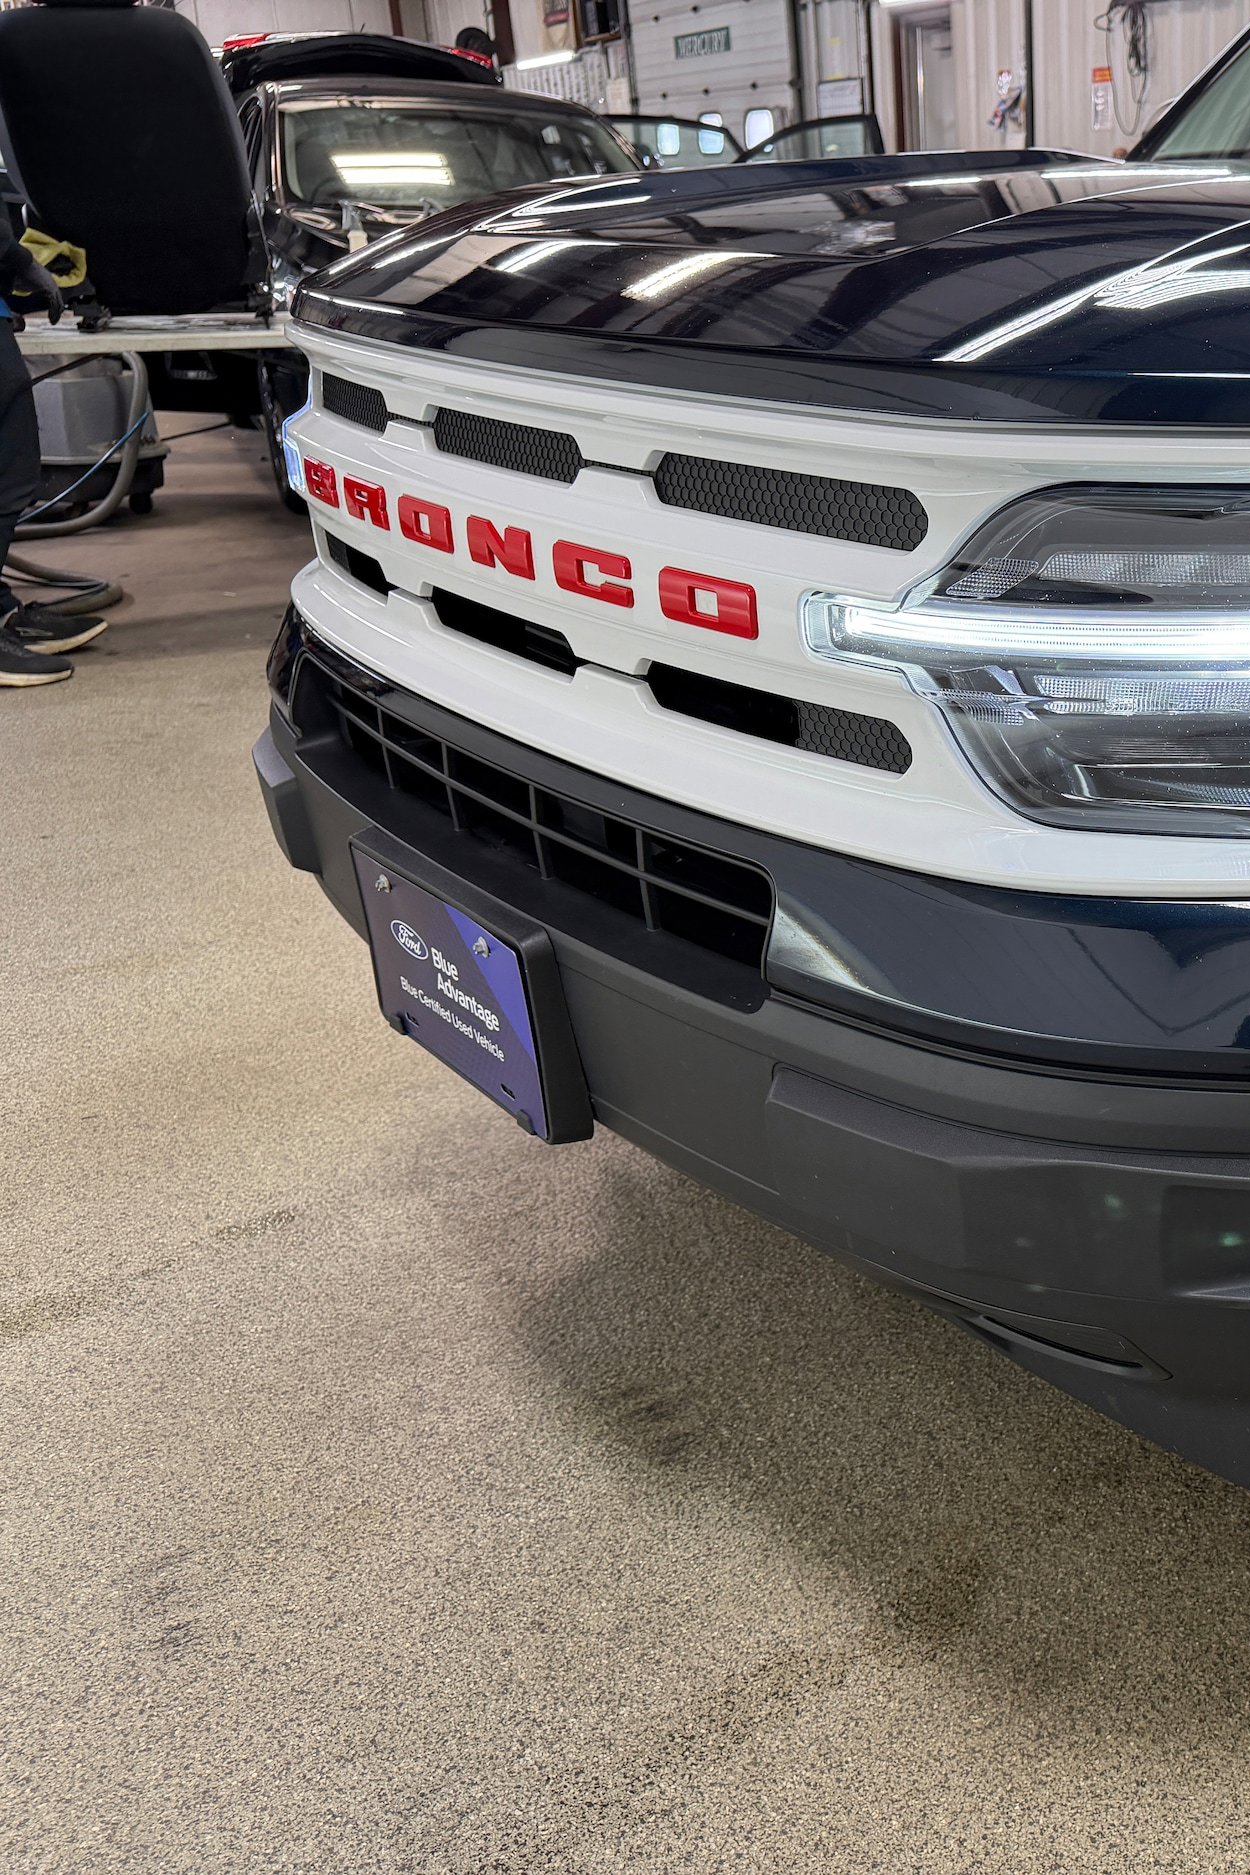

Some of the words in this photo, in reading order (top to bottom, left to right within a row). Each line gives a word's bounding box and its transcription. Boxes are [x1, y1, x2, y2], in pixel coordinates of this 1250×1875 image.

[303, 454, 760, 641] BRONCO
[397, 922, 423, 957] Ford
[430, 946, 459, 981] Blue
[400, 975, 419, 999] Blue
[418, 989, 452, 1023] Certified
[451, 1012, 474, 1039] Used
[473, 1028, 505, 1062] Vehicle
[437, 972, 500, 1032] Advantage
